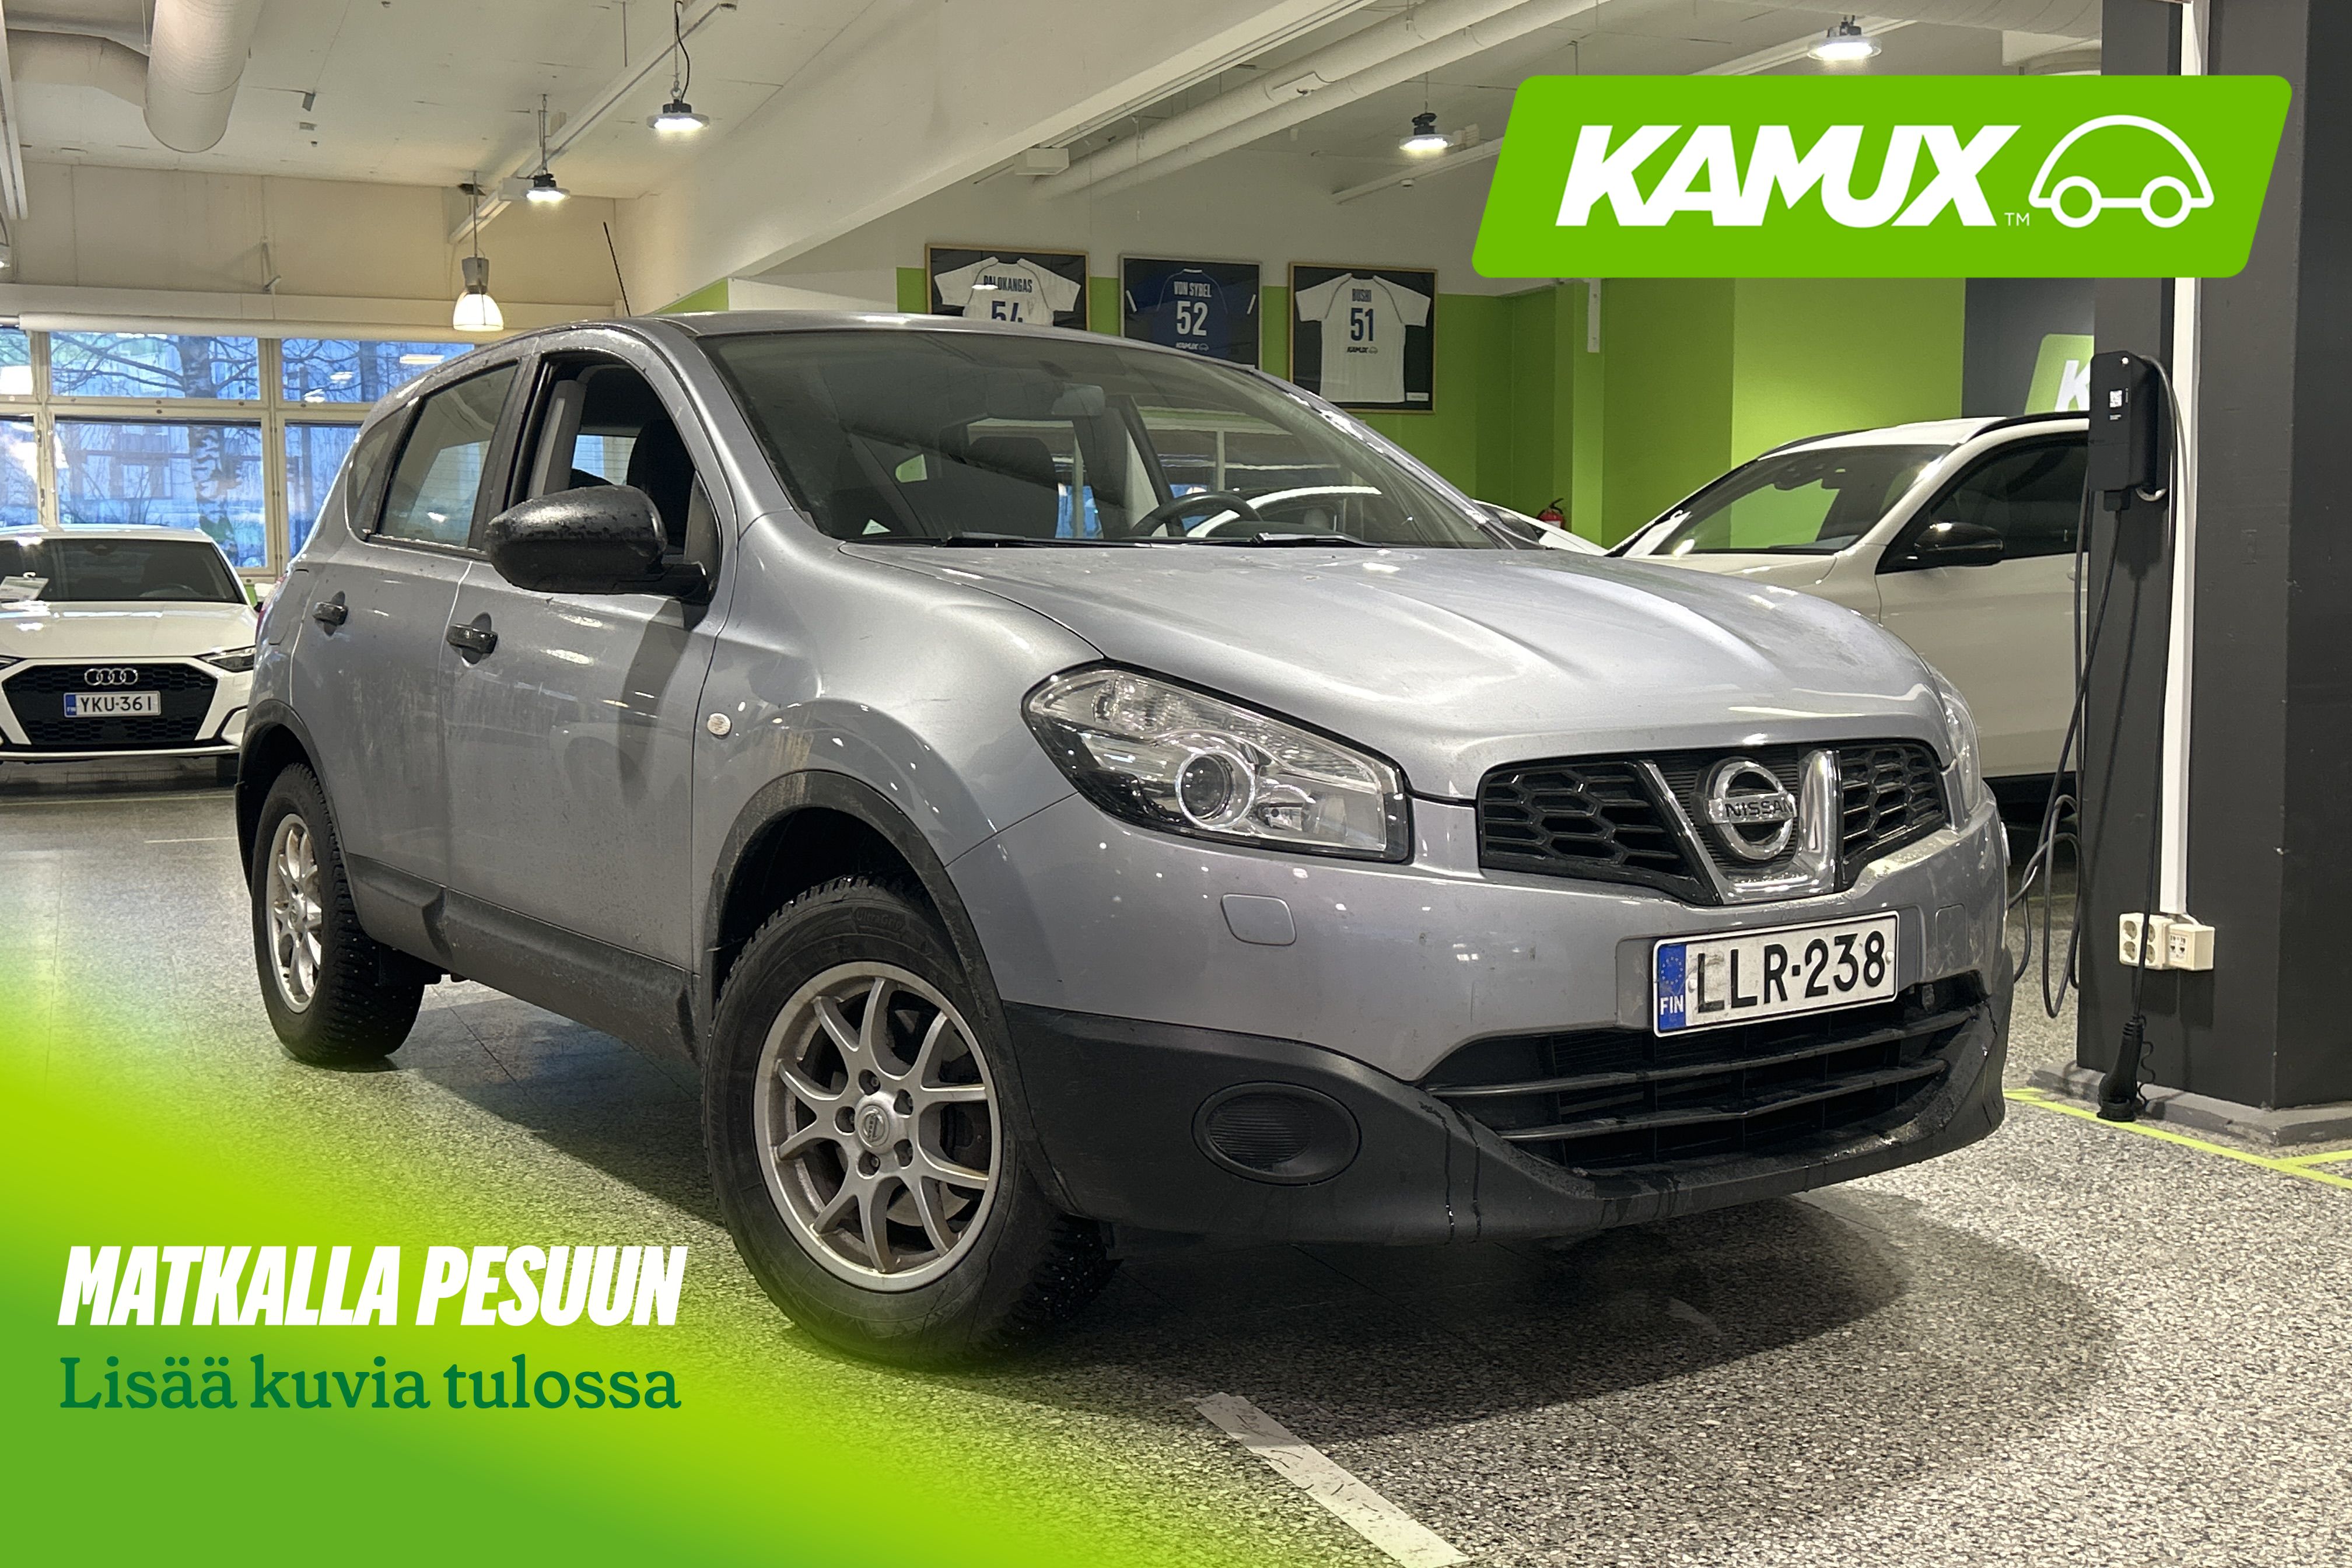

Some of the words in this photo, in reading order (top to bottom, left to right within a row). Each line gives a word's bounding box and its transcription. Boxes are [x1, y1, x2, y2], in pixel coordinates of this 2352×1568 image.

[1177, 300, 1208, 335] 52
[1351, 307, 1374, 341] 51
[80, 696, 151, 712] YKU-361
[1725, 800, 1793, 817] NISSAN
[1660, 995, 1684, 1016] FIN
[1697, 930, 1885, 1014] LLR-238
